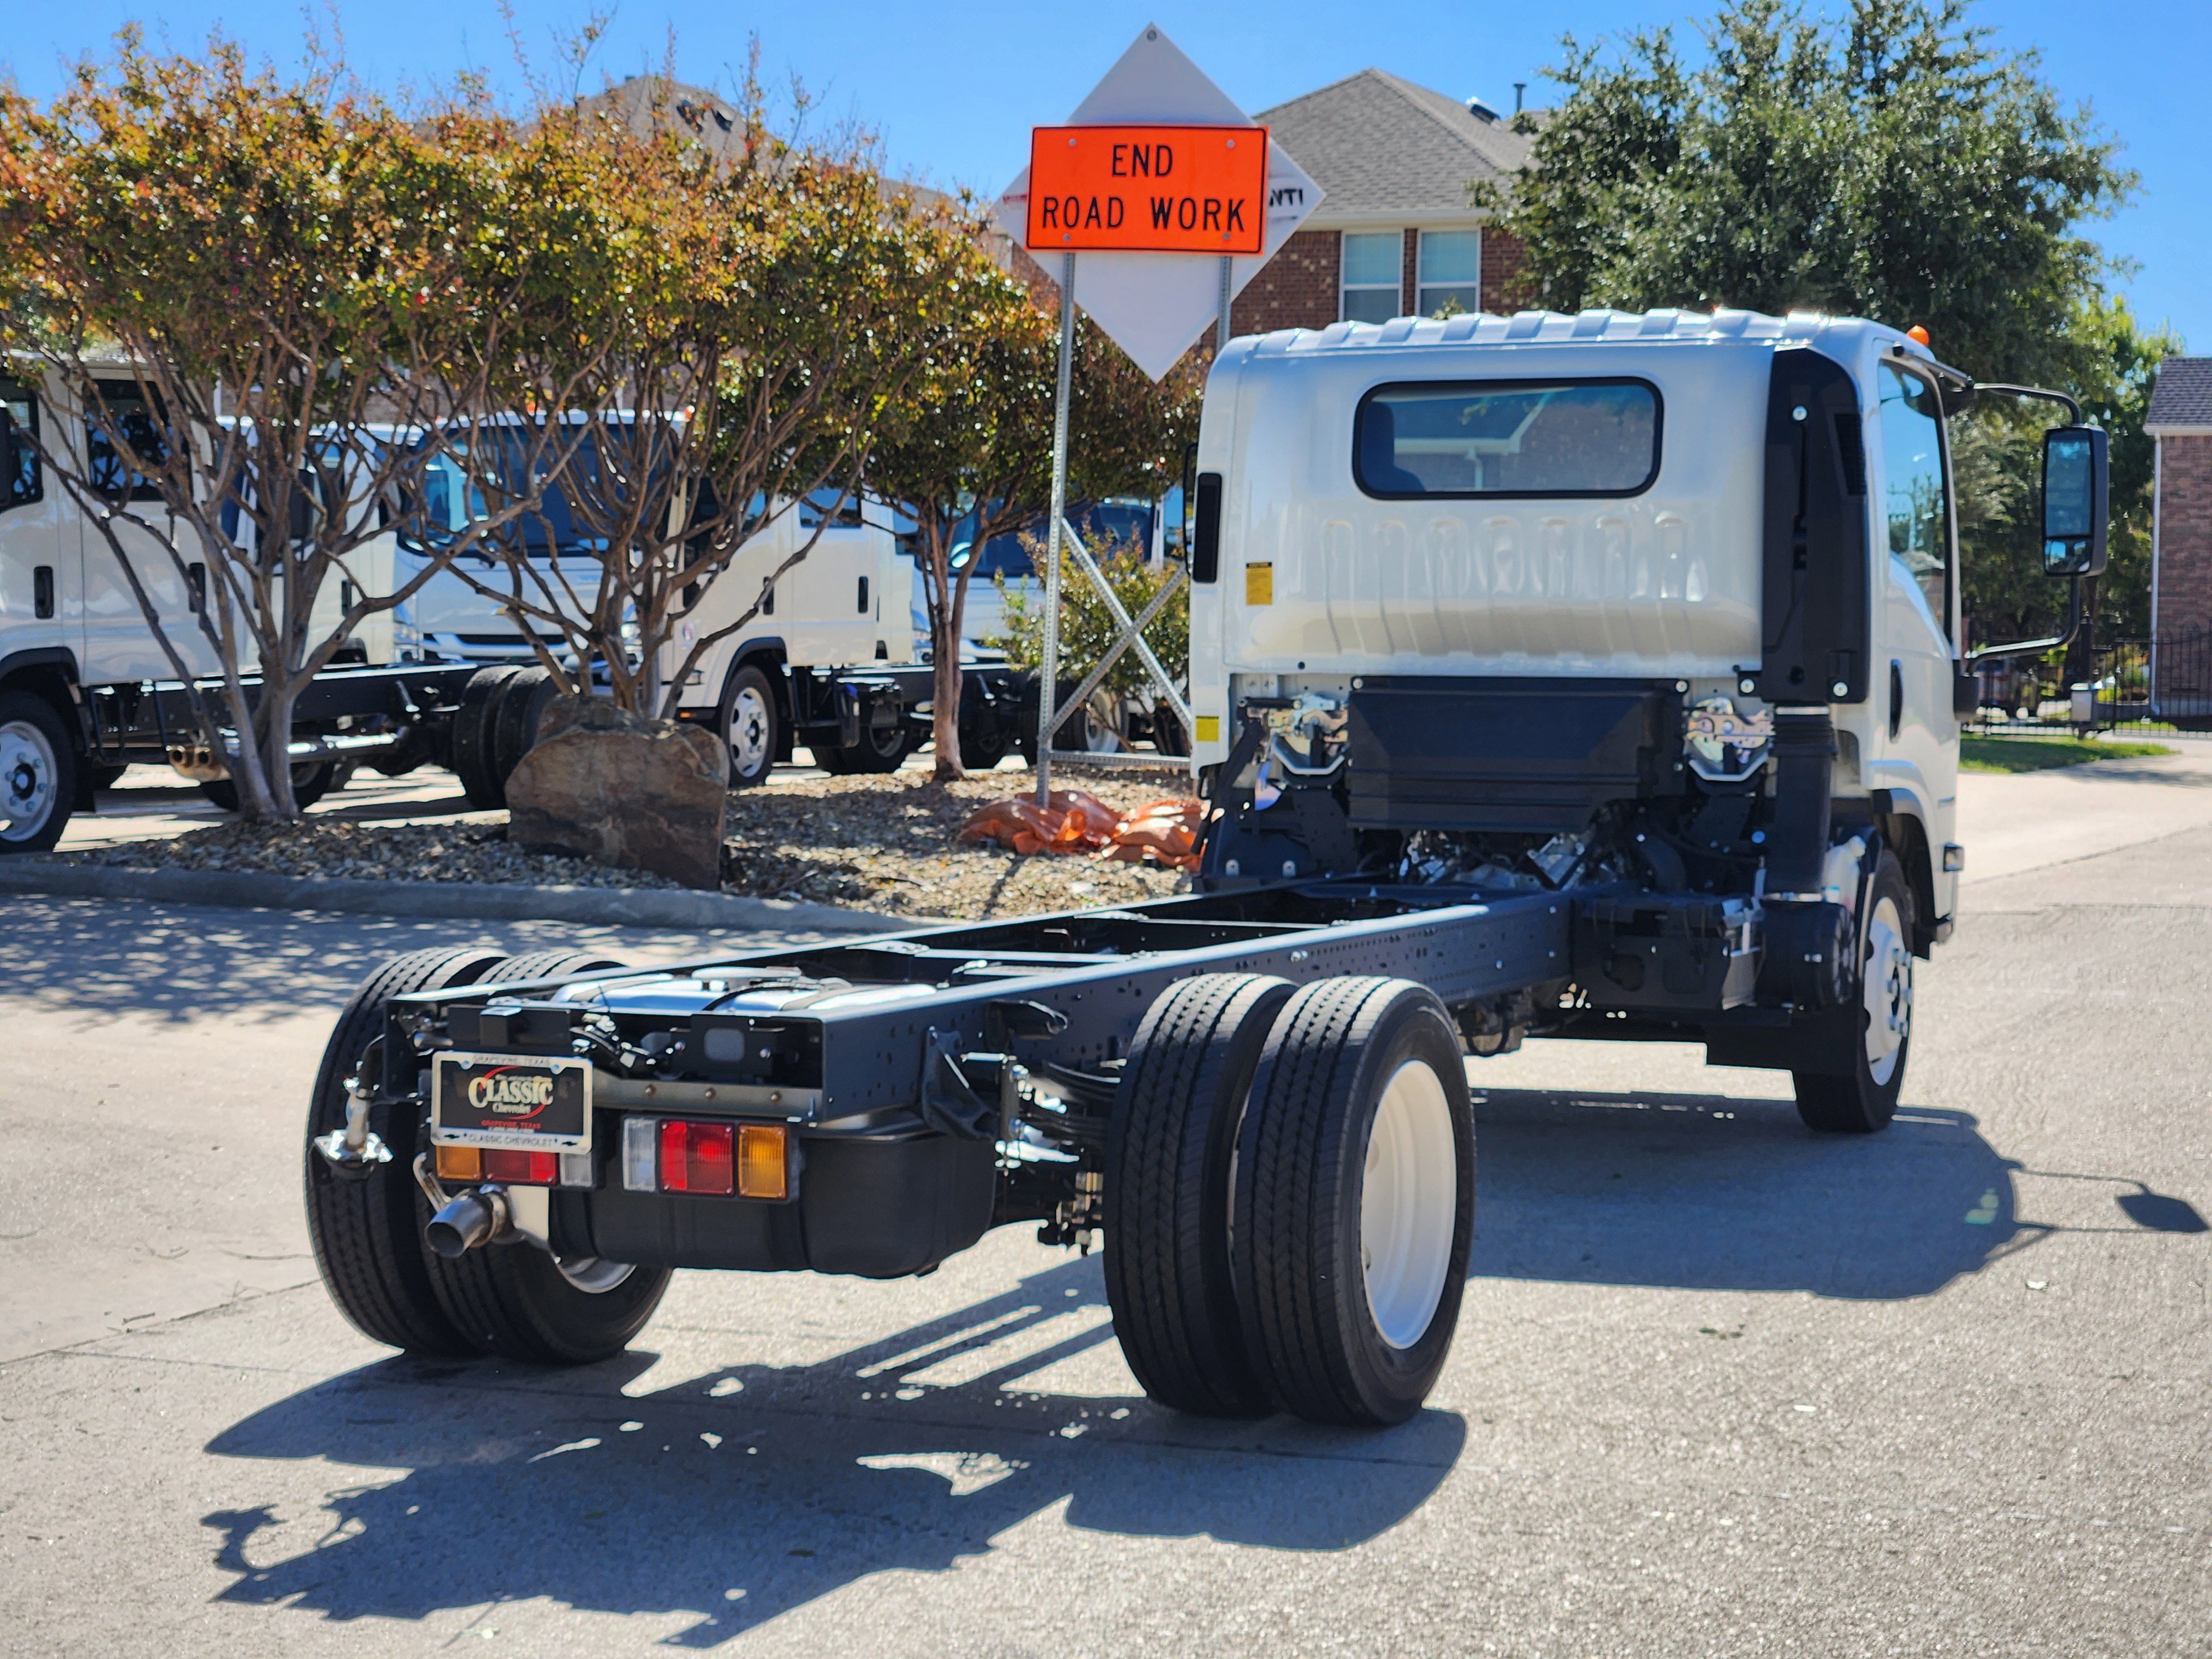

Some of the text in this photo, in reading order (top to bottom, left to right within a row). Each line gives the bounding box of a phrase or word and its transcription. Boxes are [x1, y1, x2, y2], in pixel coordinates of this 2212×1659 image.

[1111, 144, 1173, 177] END
[1042, 196, 1245, 232] ROAD WORK
[469, 1077, 553, 1108] CLASSIC
[493, 1103, 531, 1114] Chevrolet
